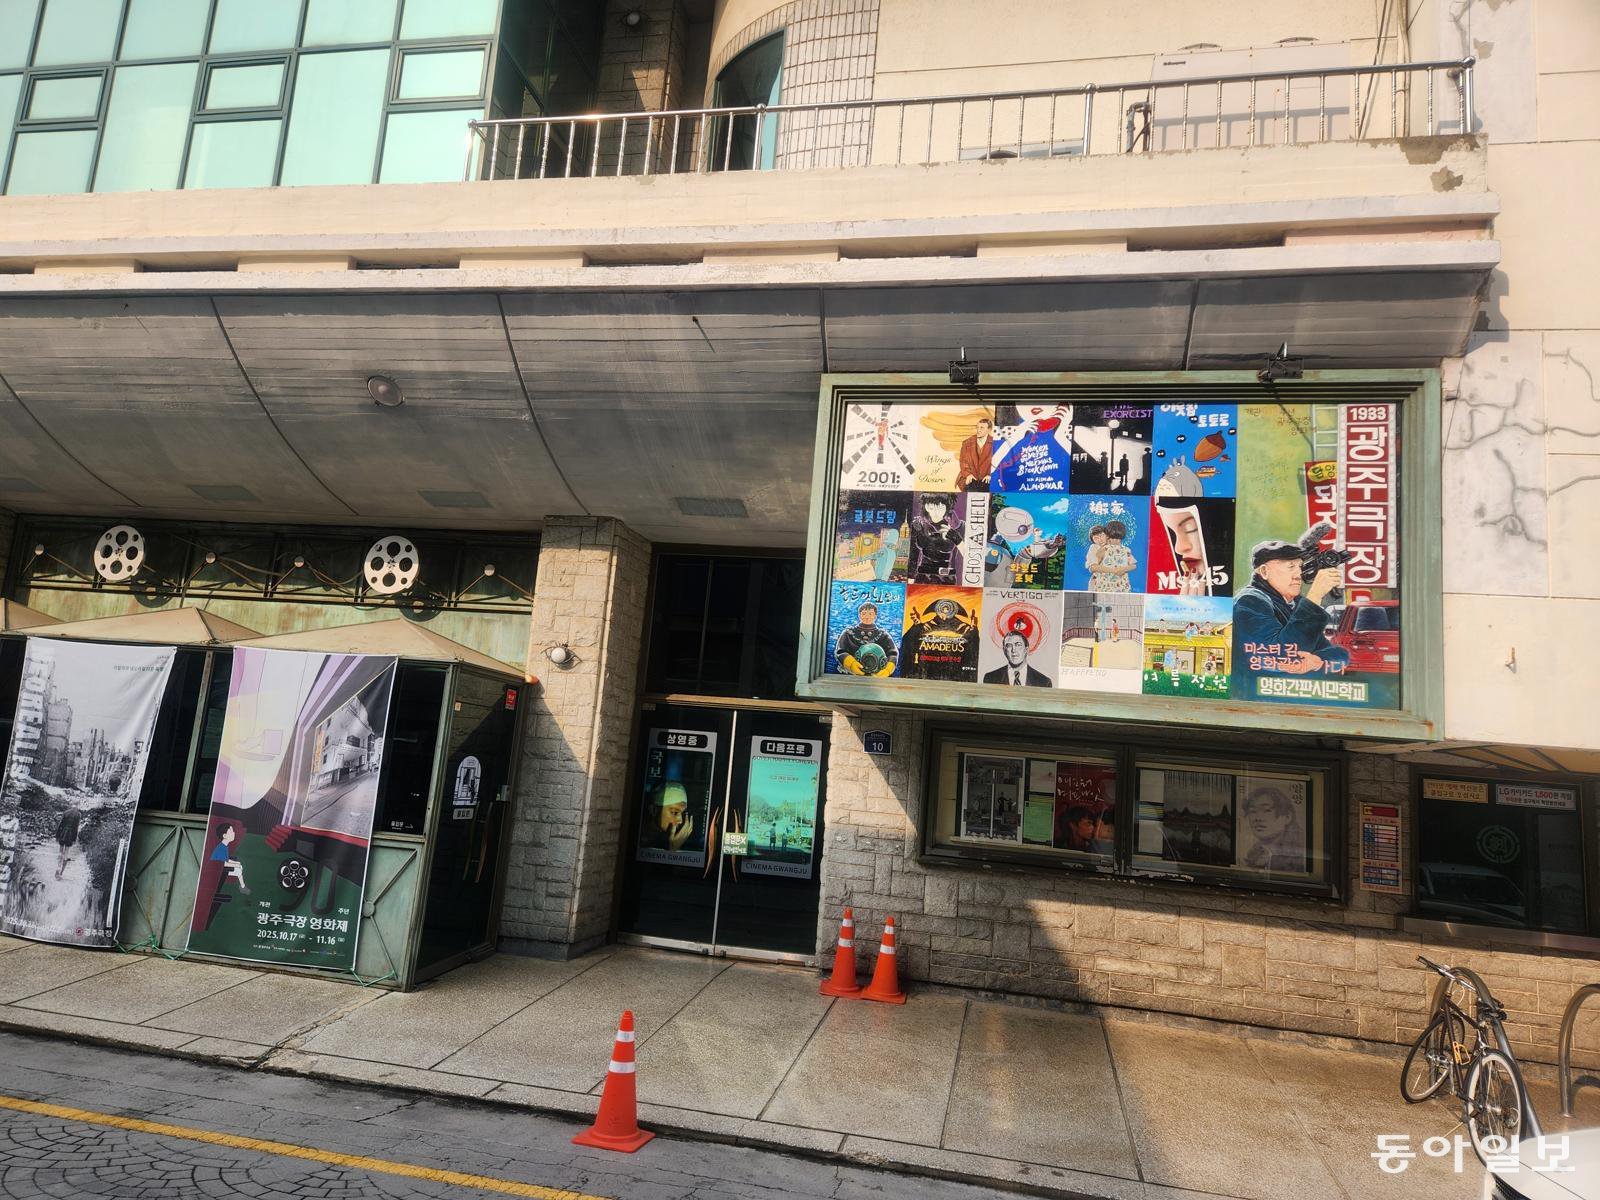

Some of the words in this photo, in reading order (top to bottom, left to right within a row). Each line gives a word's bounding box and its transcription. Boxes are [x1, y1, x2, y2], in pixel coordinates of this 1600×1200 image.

[1103, 409, 1153, 419] EXORCIST
[1197, 413, 1230, 428] 토토로
[1346, 426, 1388, 584] 광주극장
[999, 590, 1043, 600] VERTIGO
[918, 640, 965, 653] AMADEUS
[1243, 642, 1281, 656] 미스터
[1259, 677, 1365, 701] 영화간판시민학교
[667, 733, 698, 746] 상영중
[766, 742, 805, 754] 다음프로
[872, 742, 884, 752] 10
[667, 854, 701, 864] GWANGJU
[745, 862, 773, 871] CINEMA
[773, 865, 809, 875] GWANGJU
[257, 912, 308, 929] 광주극장
[309, 917, 350, 933] 영화제
[256, 929, 298, 942] 2025.10.17
[316, 935, 336, 945] 11.16
